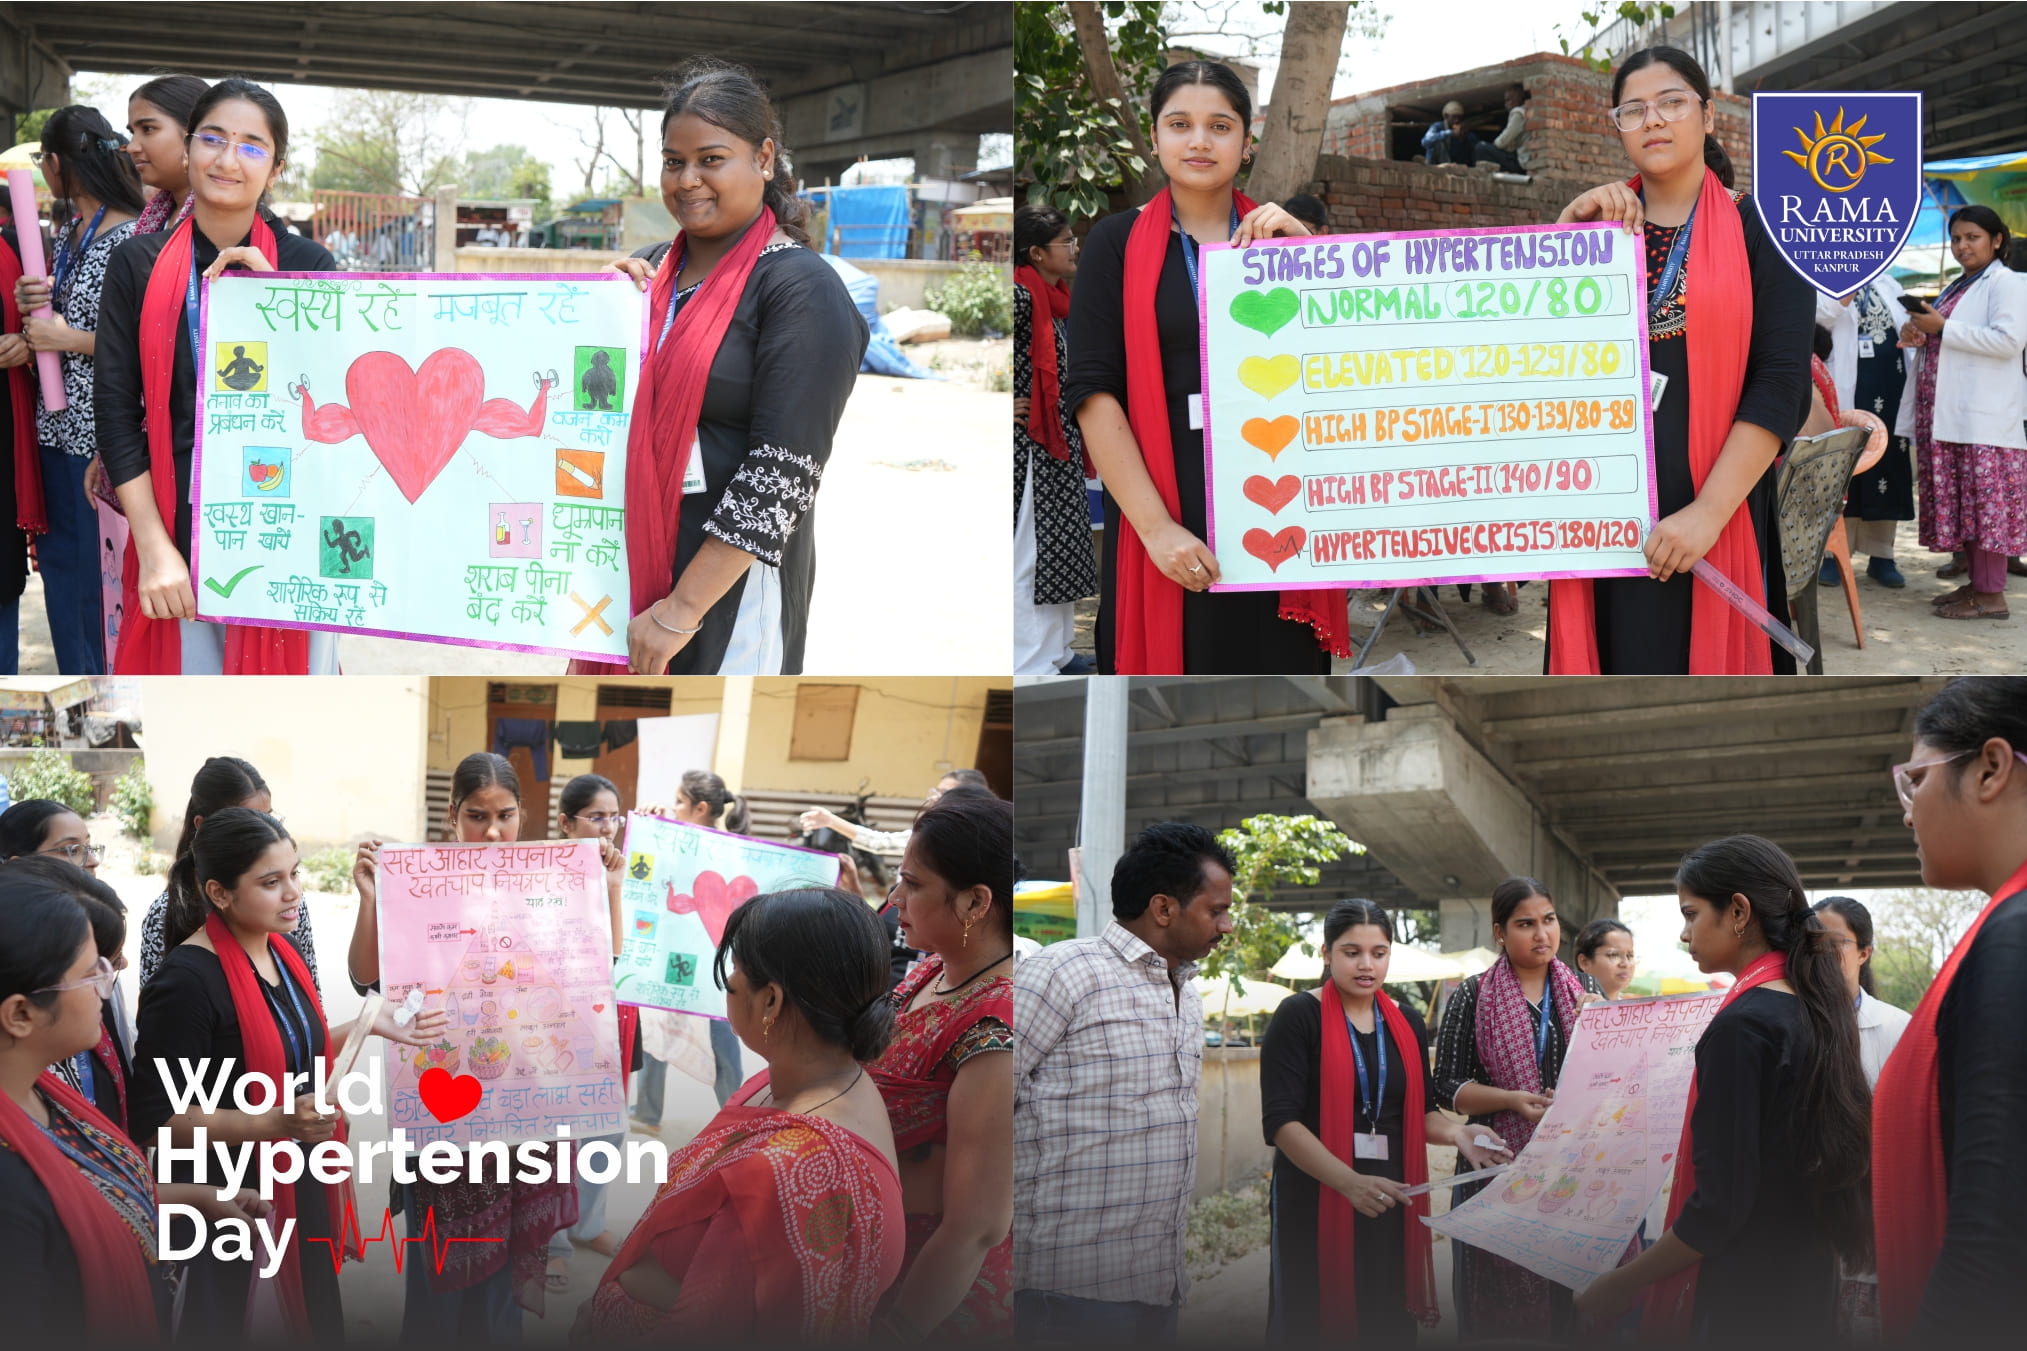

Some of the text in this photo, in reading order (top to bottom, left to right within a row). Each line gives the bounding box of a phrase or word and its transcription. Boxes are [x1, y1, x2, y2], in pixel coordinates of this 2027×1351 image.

[1243, 230, 1613, 285] STAGES OF HYPERTENSION
[428, 282, 590, 327] मजबूत रहें
[1307, 283, 1441, 325] NORMAL
[1305, 347, 1453, 389] ELEVATED
[207, 394, 270, 409] तनाव का
[261, 409, 286, 433] करें
[552, 411, 630, 428] वजन कम
[1305, 412, 1367, 445] HIGH
[1375, 409, 1400, 442] BP
[1308, 475, 1366, 507] HIGH
[1370, 472, 1394, 504] BP
[213, 530, 247, 550] पान
[550, 538, 621, 572] ना करें
[1313, 525, 1472, 564] HYPERTENSIVE
[266, 575, 328, 604] शारीरिक
[369, 580, 388, 607] से
[464, 561, 572, 595] शराब पीना
[467, 592, 548, 626] बंद करें
[428, 846, 488, 871] आहार
[1610, 1001, 1656, 1027] आहार
[532, 1085, 572, 1109] लाभ
[576, 1077, 619, 1106] सही
